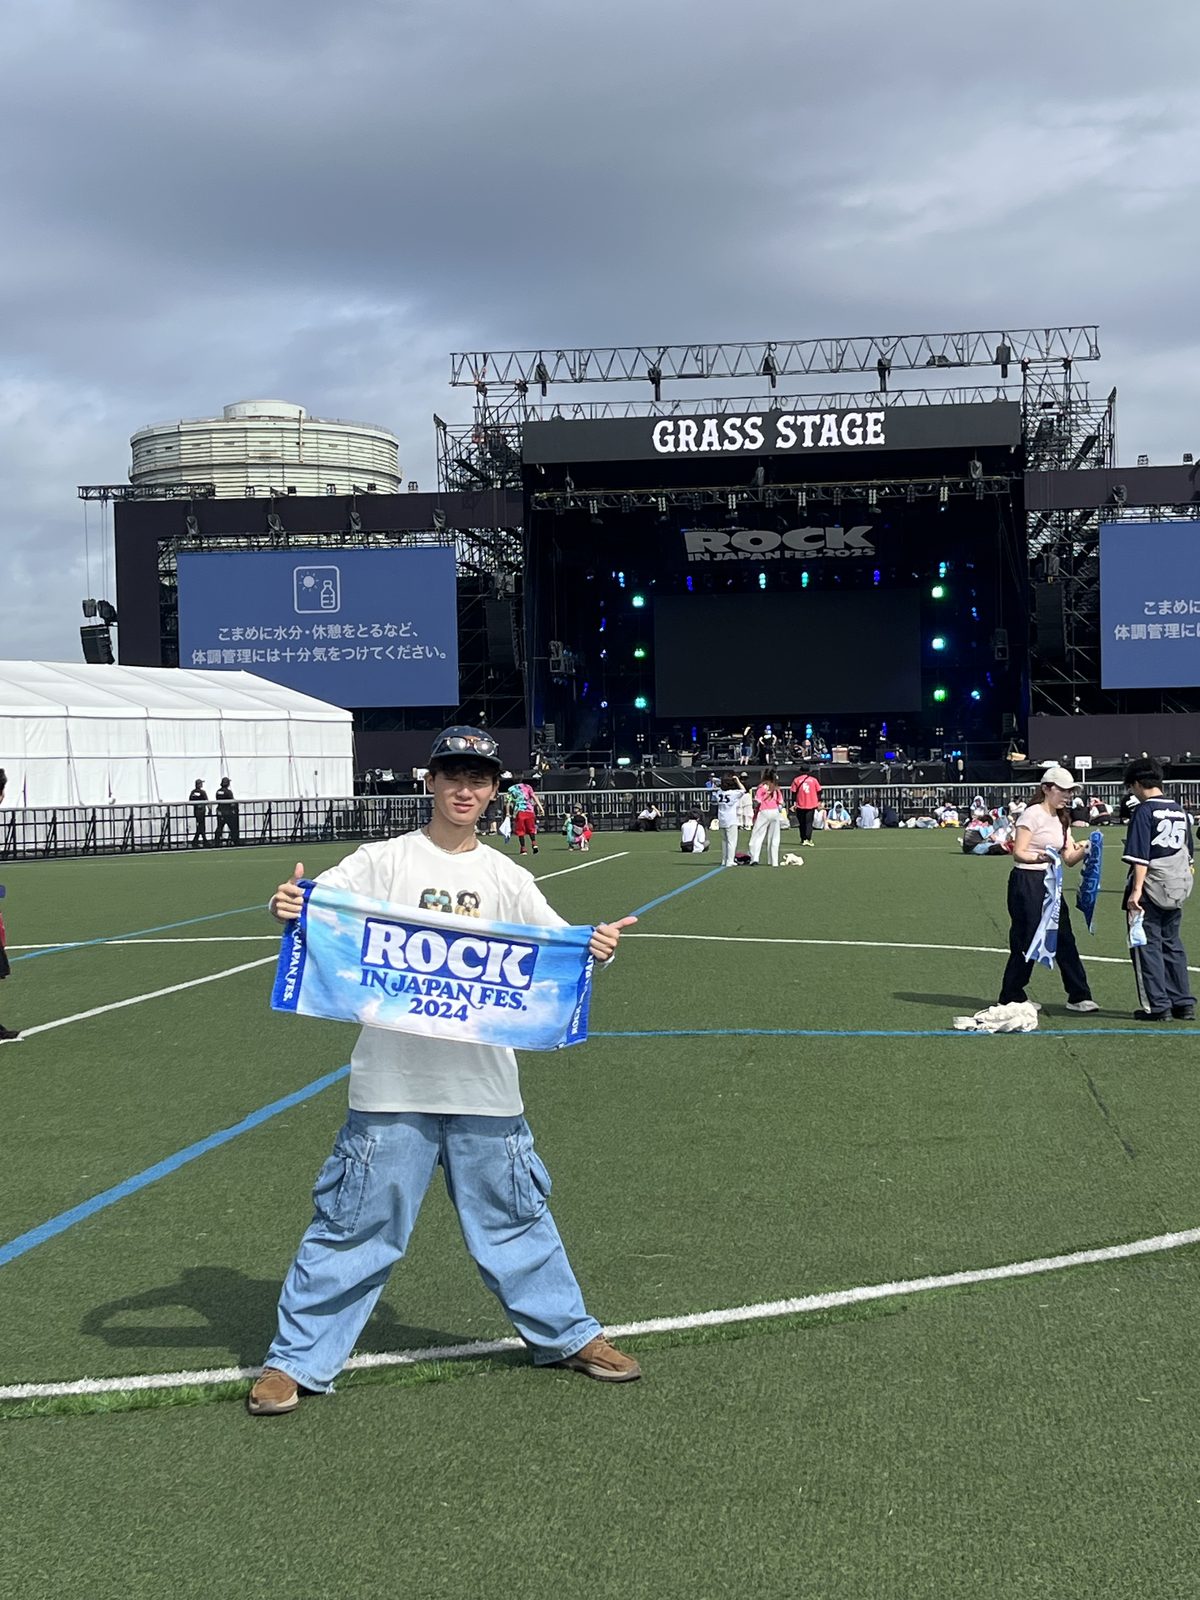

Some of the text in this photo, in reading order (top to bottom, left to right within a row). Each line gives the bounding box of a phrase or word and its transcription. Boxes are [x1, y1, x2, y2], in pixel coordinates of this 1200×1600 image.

[652, 411, 886, 453] GRASS STAGE
[684, 525, 875, 553] ROCK
[688, 552, 711, 561] IN
[713, 550, 781, 561] JAPAN
[1143, 599, 1200, 615] こまめに
[1114, 622, 1200, 641] 体調管理に
[1151, 819, 1186, 849] 25
[363, 921, 534, 988] ROCK
[360, 969, 528, 1011] IN JAPAN FES.
[408, 997, 469, 1022] 2024
